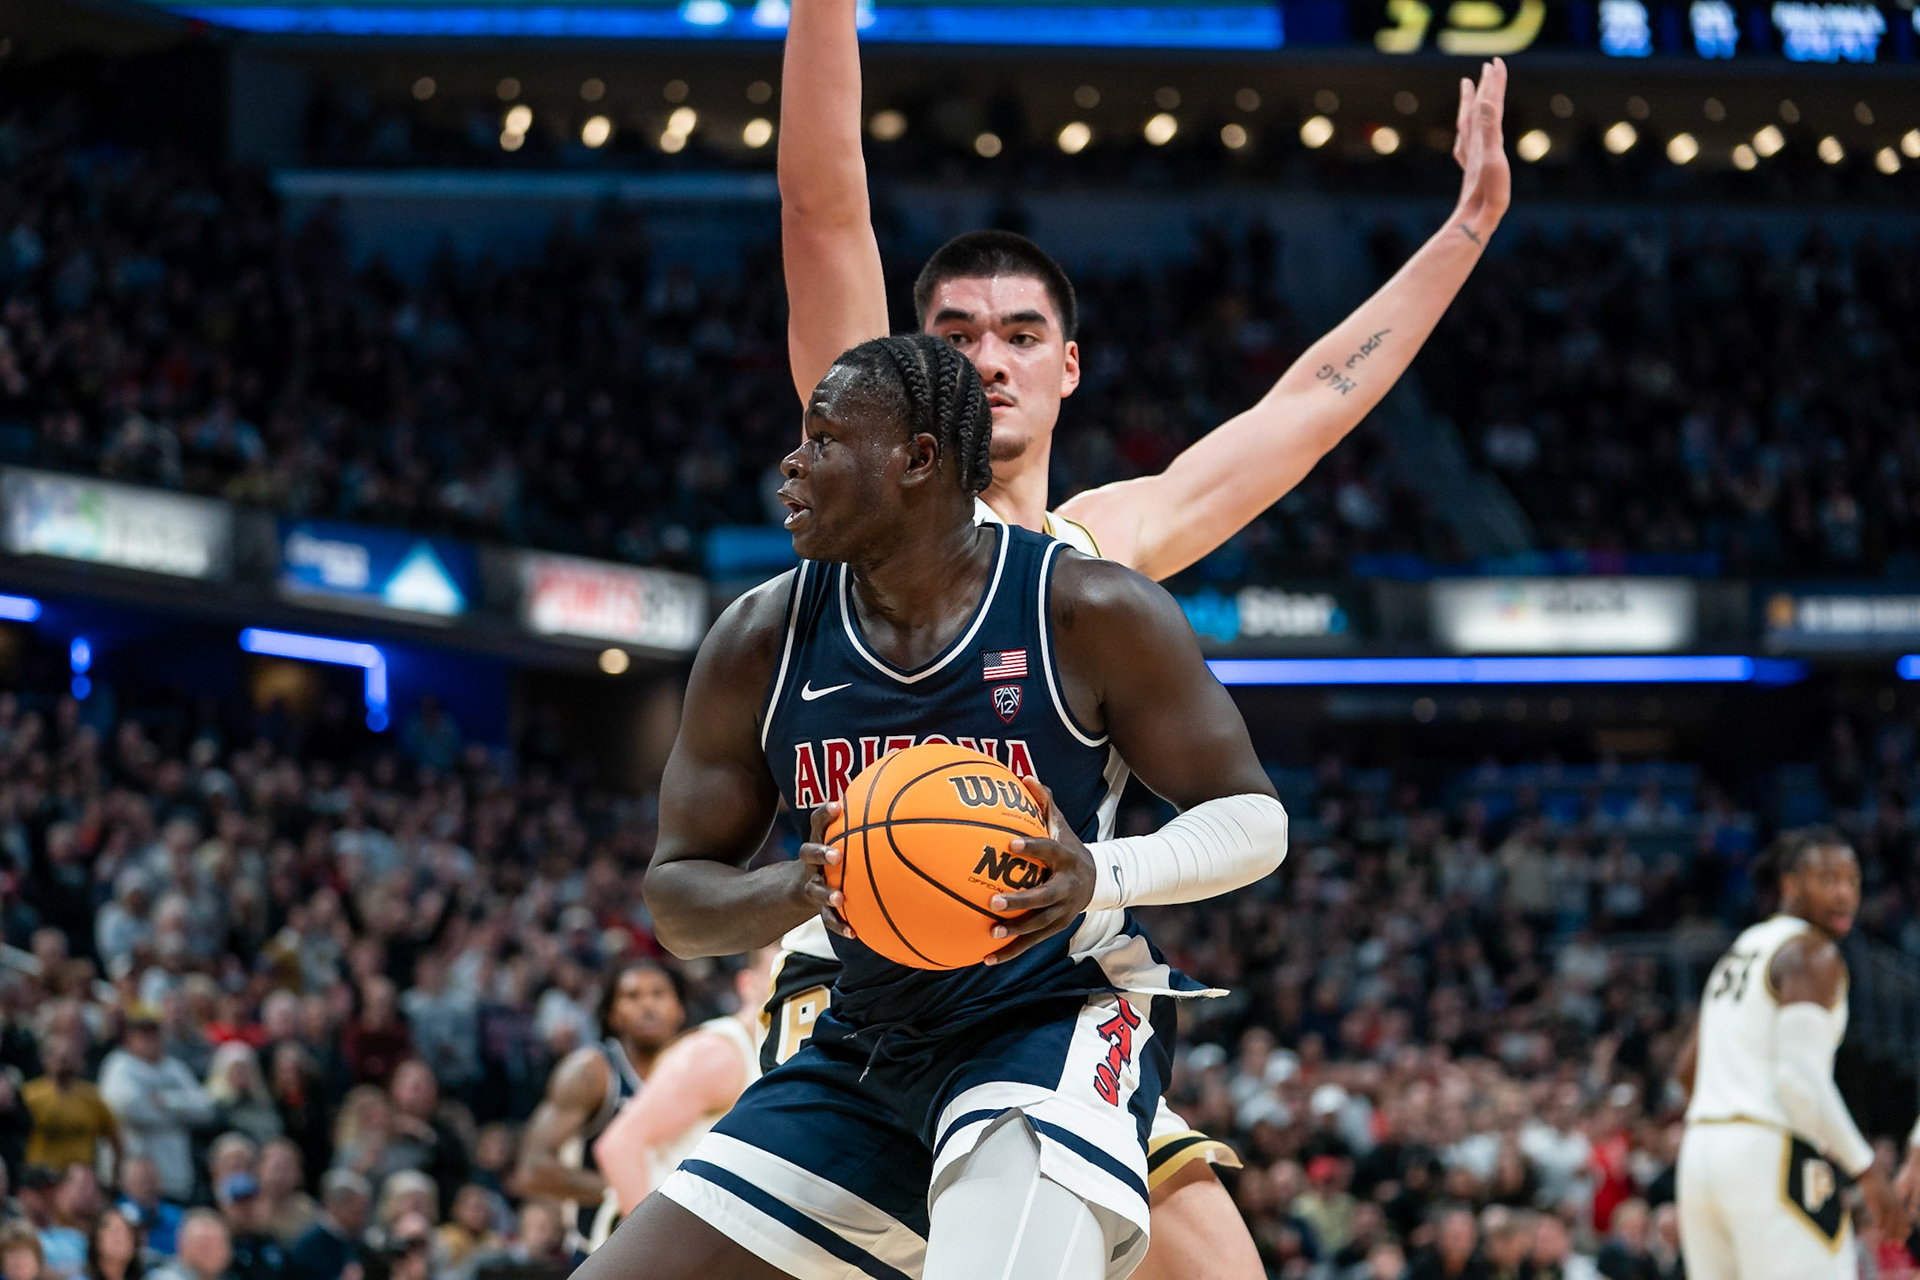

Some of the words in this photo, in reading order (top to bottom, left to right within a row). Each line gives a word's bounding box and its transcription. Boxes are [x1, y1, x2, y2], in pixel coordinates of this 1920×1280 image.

[994, 687, 1020, 708] PAC
[1000, 700, 1015, 715] 12
[795, 734, 1041, 810] ARIA
[948, 775, 1047, 828] Wils
